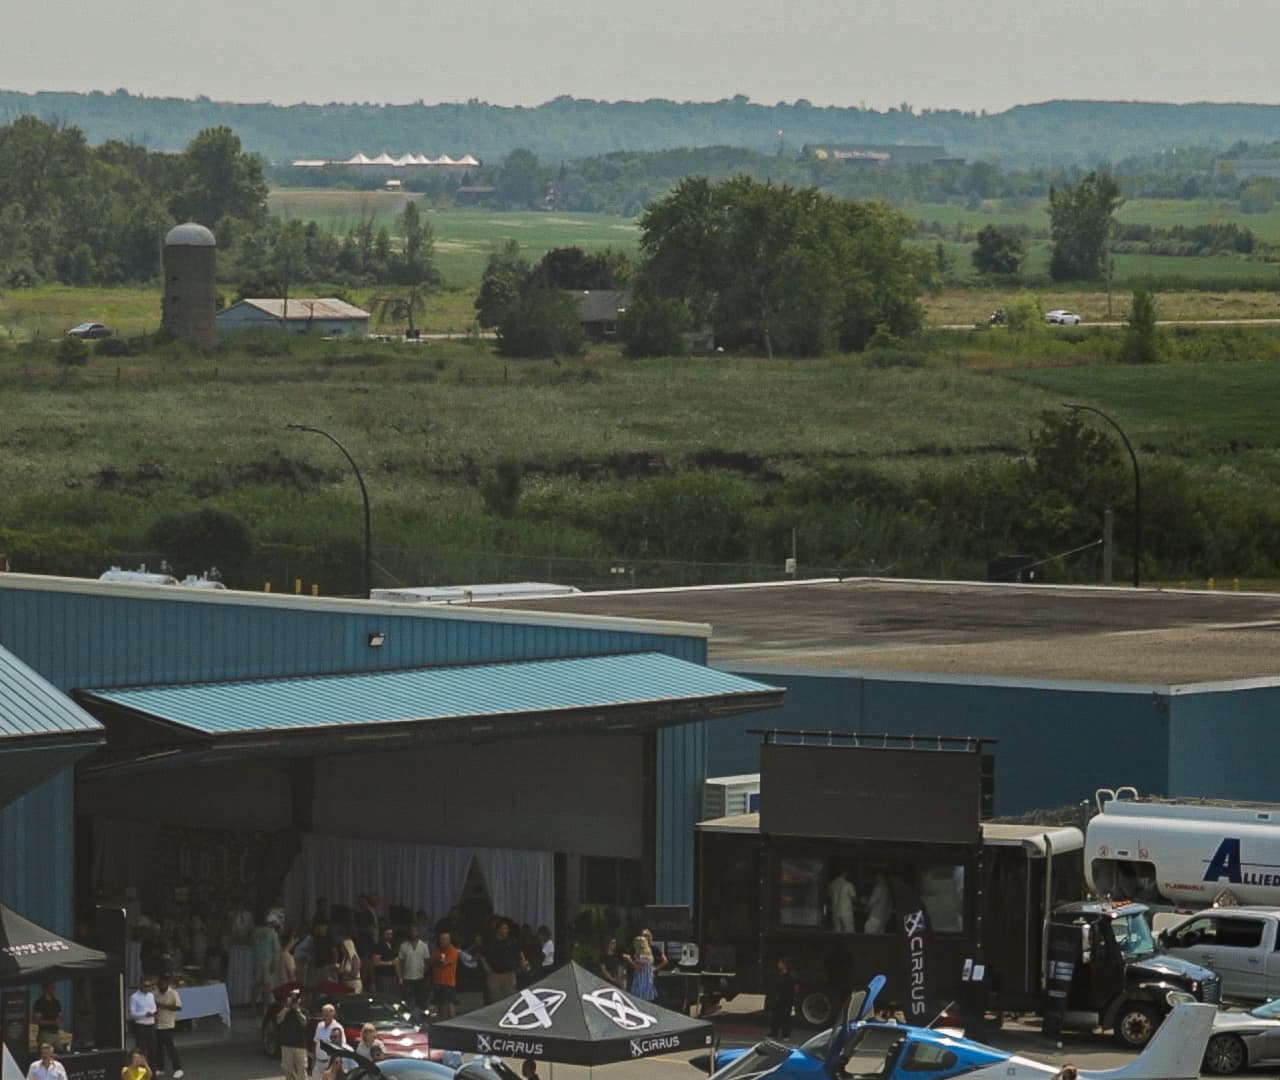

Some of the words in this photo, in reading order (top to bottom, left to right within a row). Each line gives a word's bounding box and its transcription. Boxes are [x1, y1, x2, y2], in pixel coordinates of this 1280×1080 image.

[910, 936, 925, 1016] CIRRUS
[493, 1038, 544, 1055] CIRRUS
[642, 1035, 680, 1053] CIRRUS
